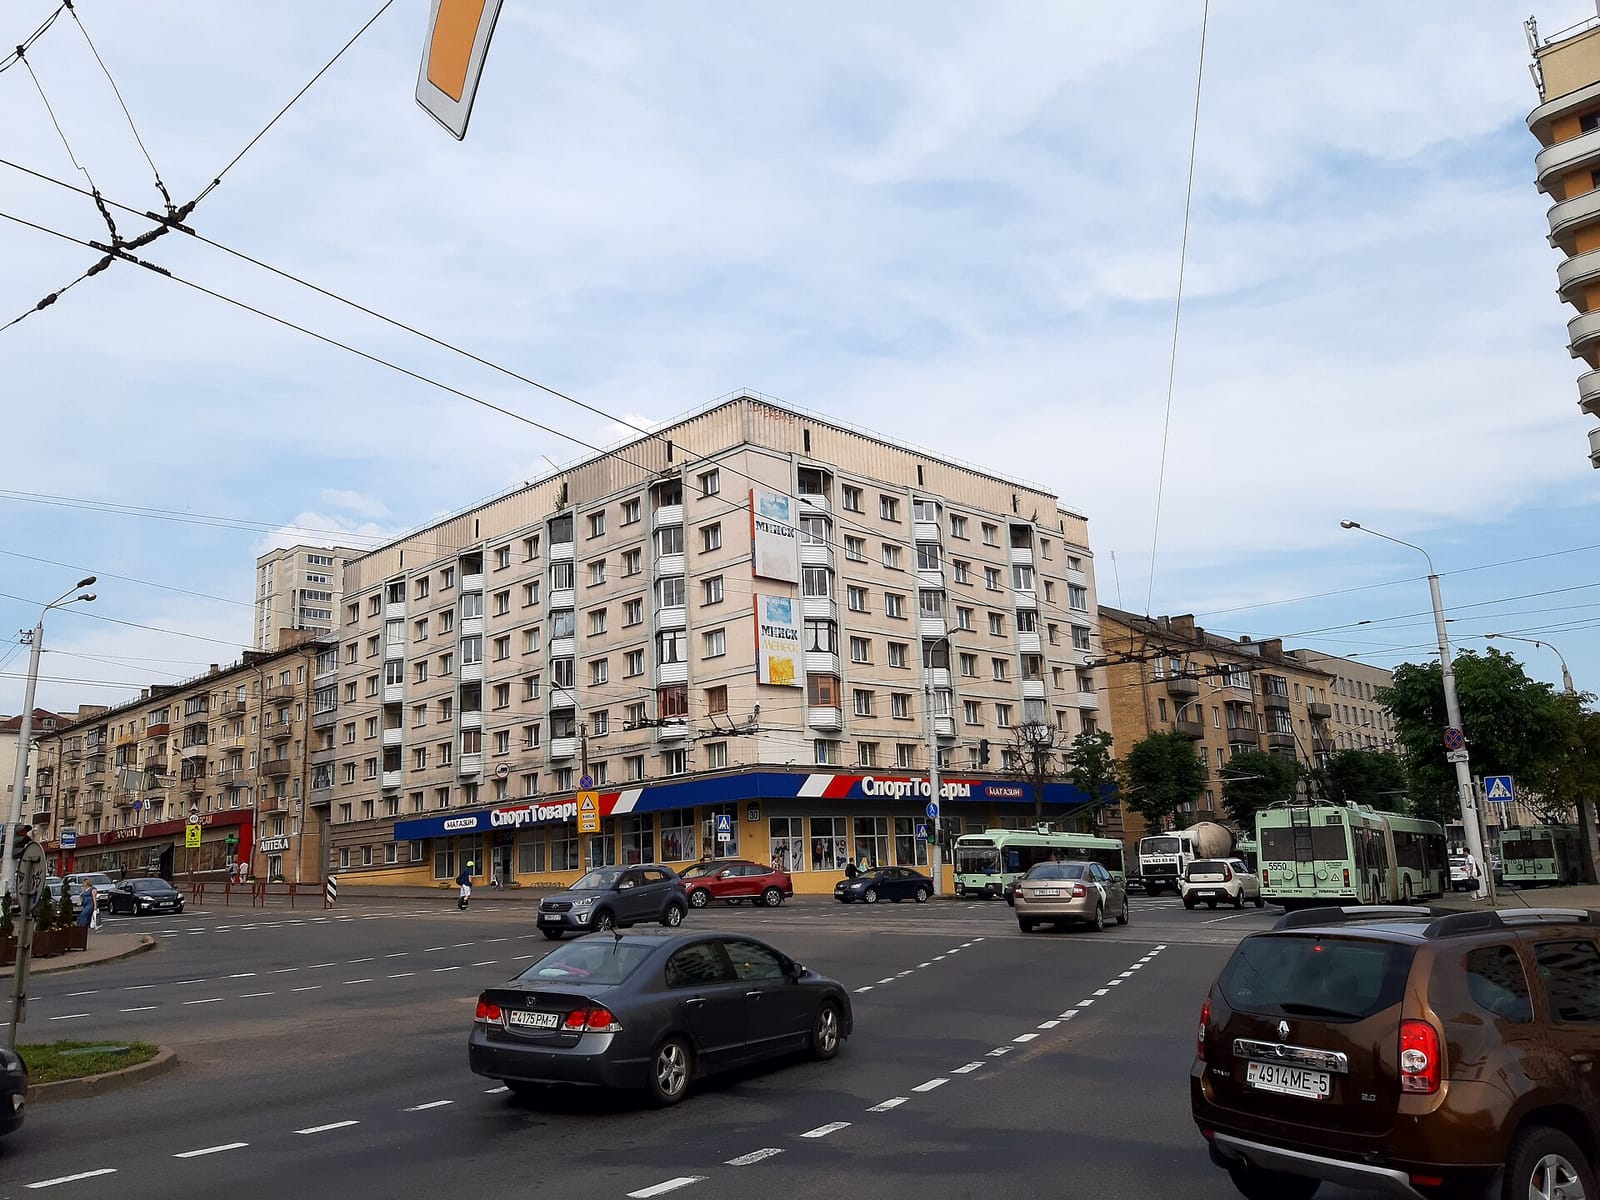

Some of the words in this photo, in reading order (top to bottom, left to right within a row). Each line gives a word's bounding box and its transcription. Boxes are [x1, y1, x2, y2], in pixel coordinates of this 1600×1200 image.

[756, 521, 794, 538] МИНСК
[761, 625, 798, 641] МИНСК
[862, 776, 971, 800] СпортТоары
[988, 786, 1020, 797] МАГАЗИН
[749, 811, 758, 820] 30
[446, 818, 475, 829] МАГАЗИН
[260, 838, 288, 852] АПТЕКА
[1268, 862, 1287, 871] 5550
